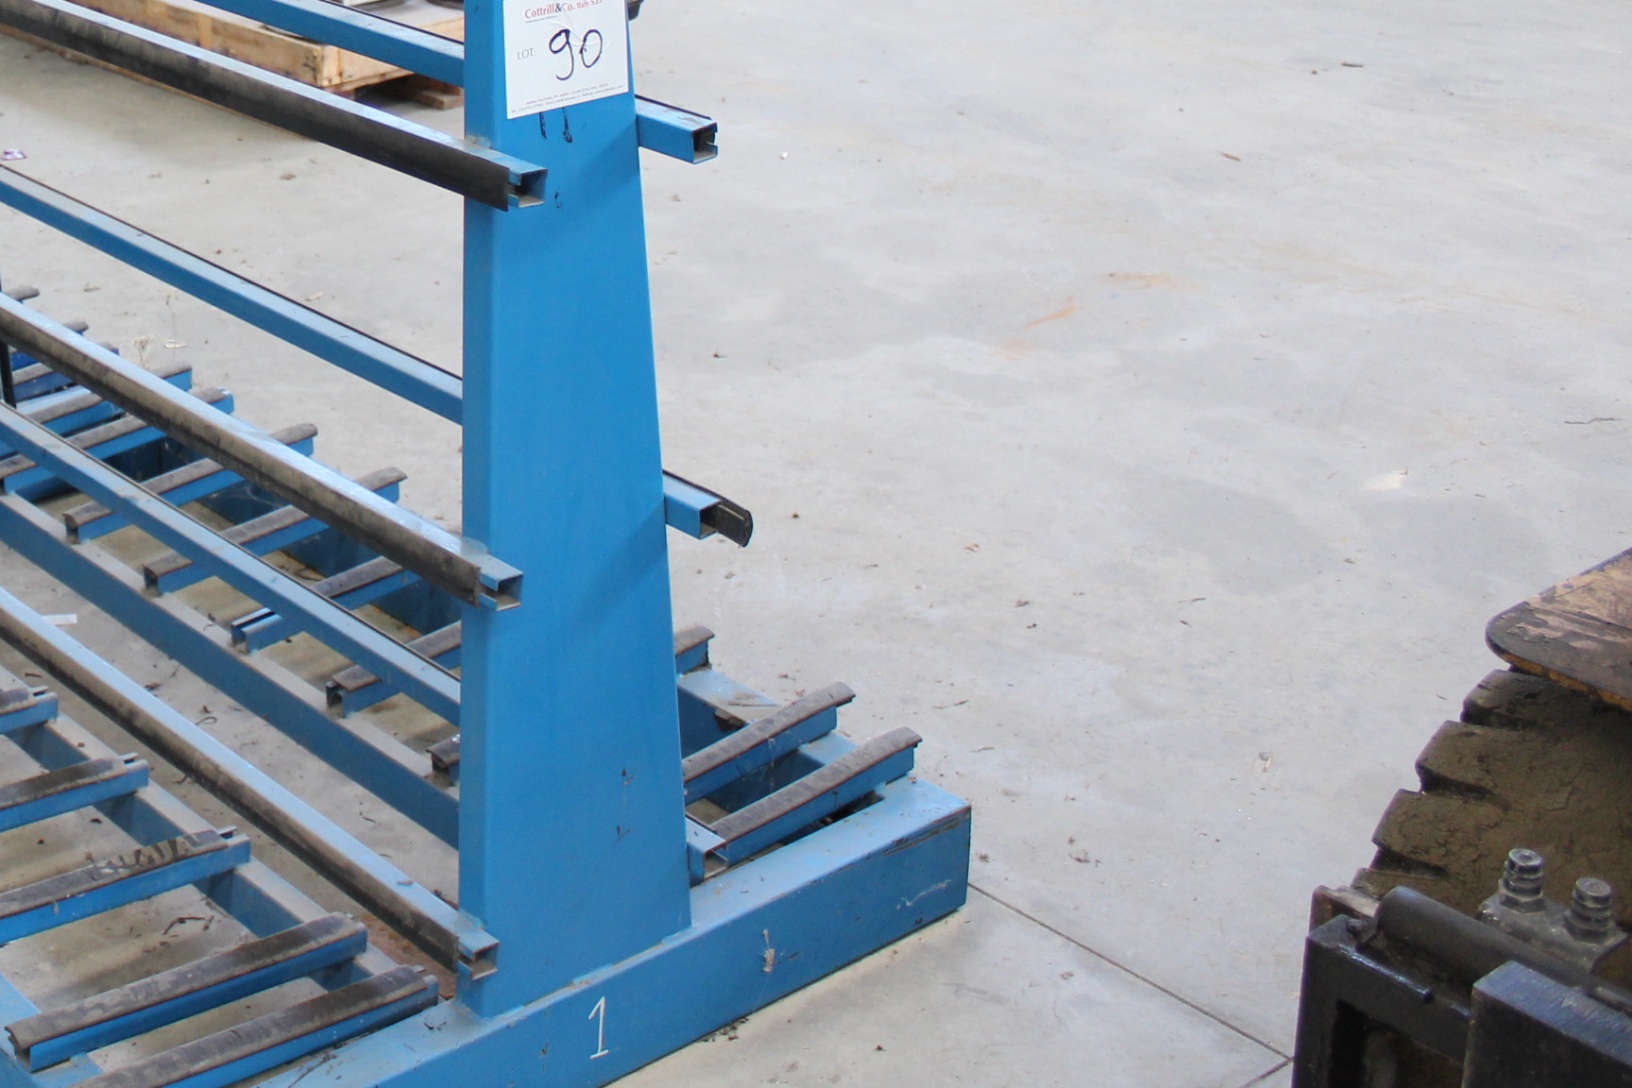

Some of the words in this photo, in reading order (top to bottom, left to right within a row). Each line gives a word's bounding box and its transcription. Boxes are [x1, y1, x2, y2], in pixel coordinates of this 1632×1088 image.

[576, 1, 589, 10] Italy
[516, 47, 536, 60] LOT:
[548, 28, 603, 81] 90
[588, 996, 609, 1060] 1
